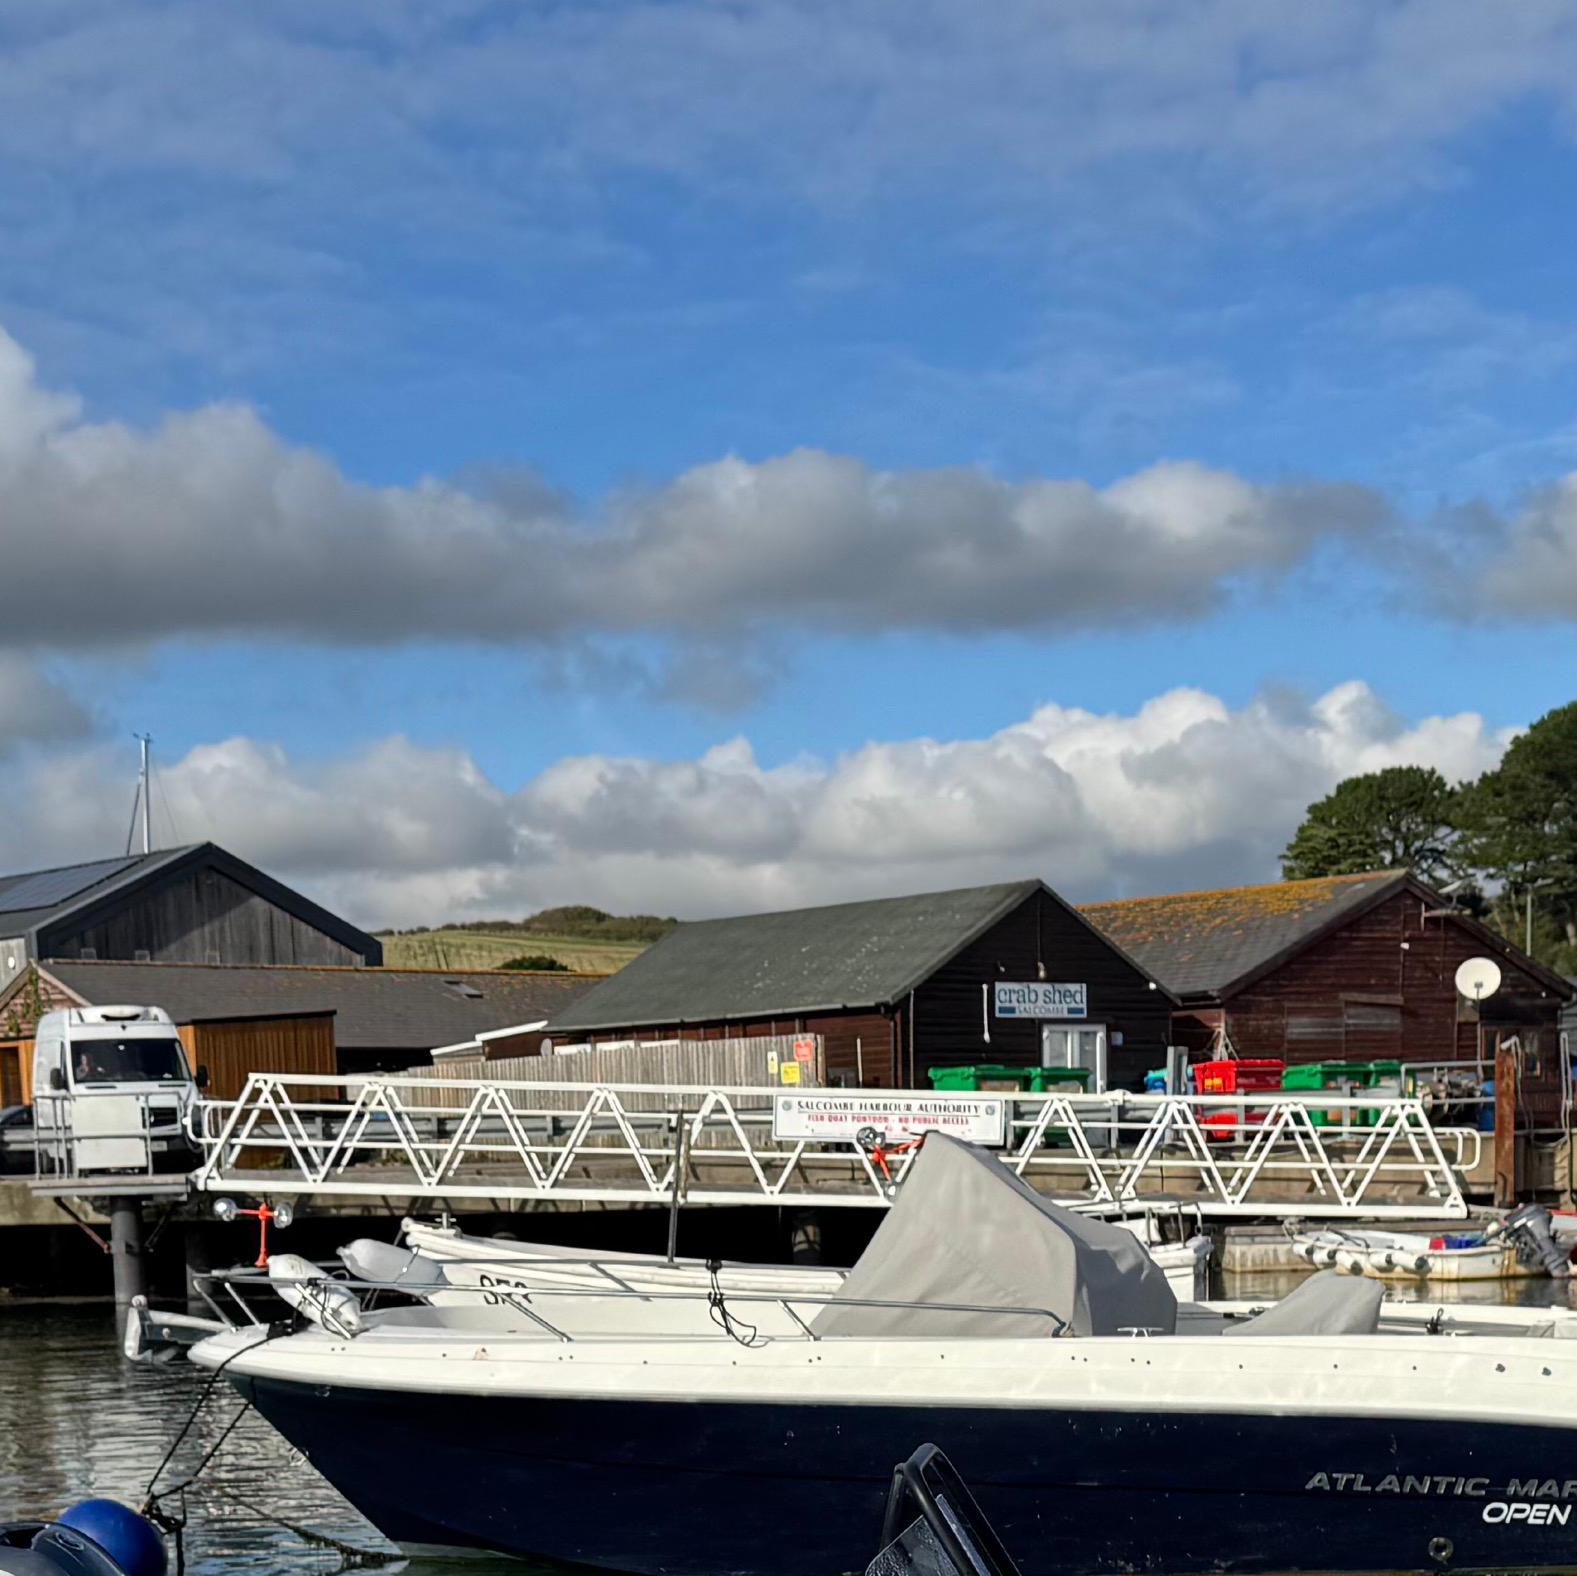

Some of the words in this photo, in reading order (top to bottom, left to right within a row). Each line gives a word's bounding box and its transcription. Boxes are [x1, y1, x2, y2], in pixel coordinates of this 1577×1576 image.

[997, 984, 1039, 1004] crab
[1043, 983, 1084, 1005] shed
[797, 1100, 854, 1111] SALCOMBE
[859, 1102, 912, 1112] HARBOUR
[918, 1102, 980, 1114] AUTHORITY
[1305, 1471, 1491, 1496] ATLANTIC
[1482, 1501, 1572, 1526] OPEN
